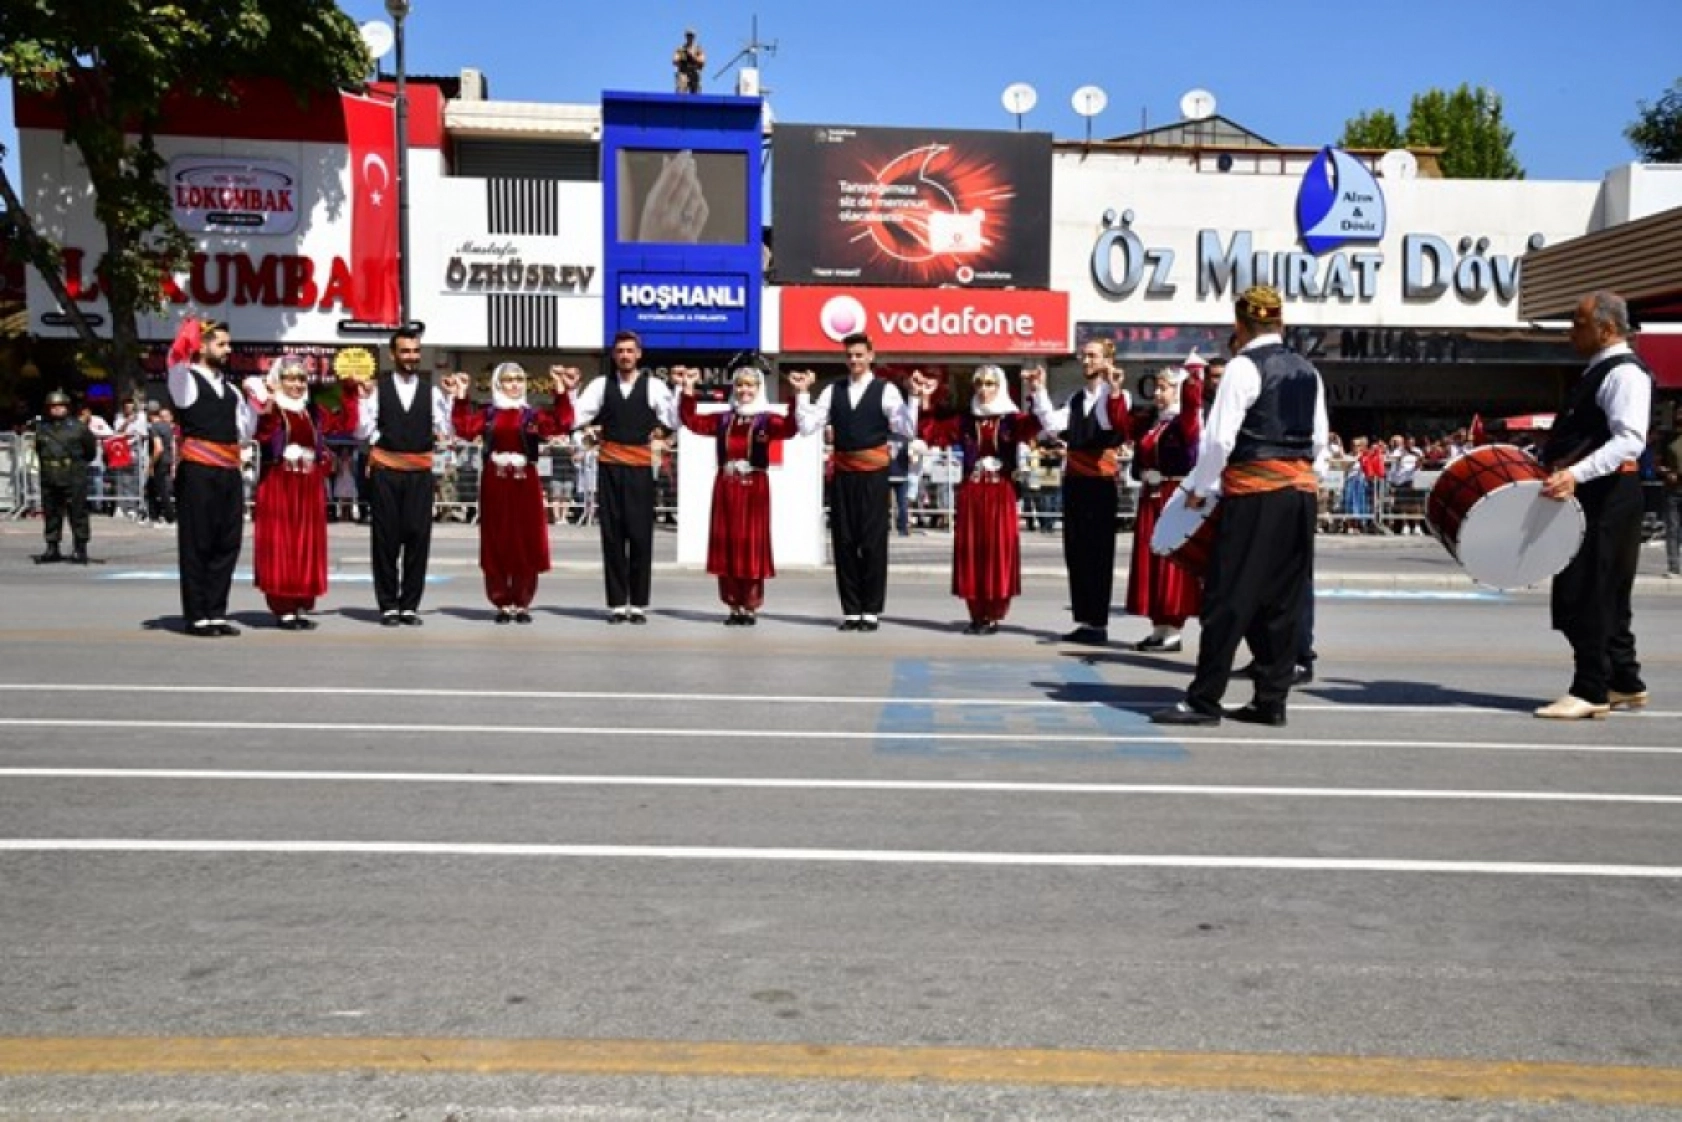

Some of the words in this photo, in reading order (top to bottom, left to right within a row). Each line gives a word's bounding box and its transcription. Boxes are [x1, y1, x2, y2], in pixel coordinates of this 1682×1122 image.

[175, 185, 294, 211] LOKUMBAK
[446, 256, 597, 292] ÖZHÜSREV
[1197, 229, 1385, 302] MURAT
[620, 284, 746, 311] HOŞHANLI
[877, 306, 1035, 336] vodafone
